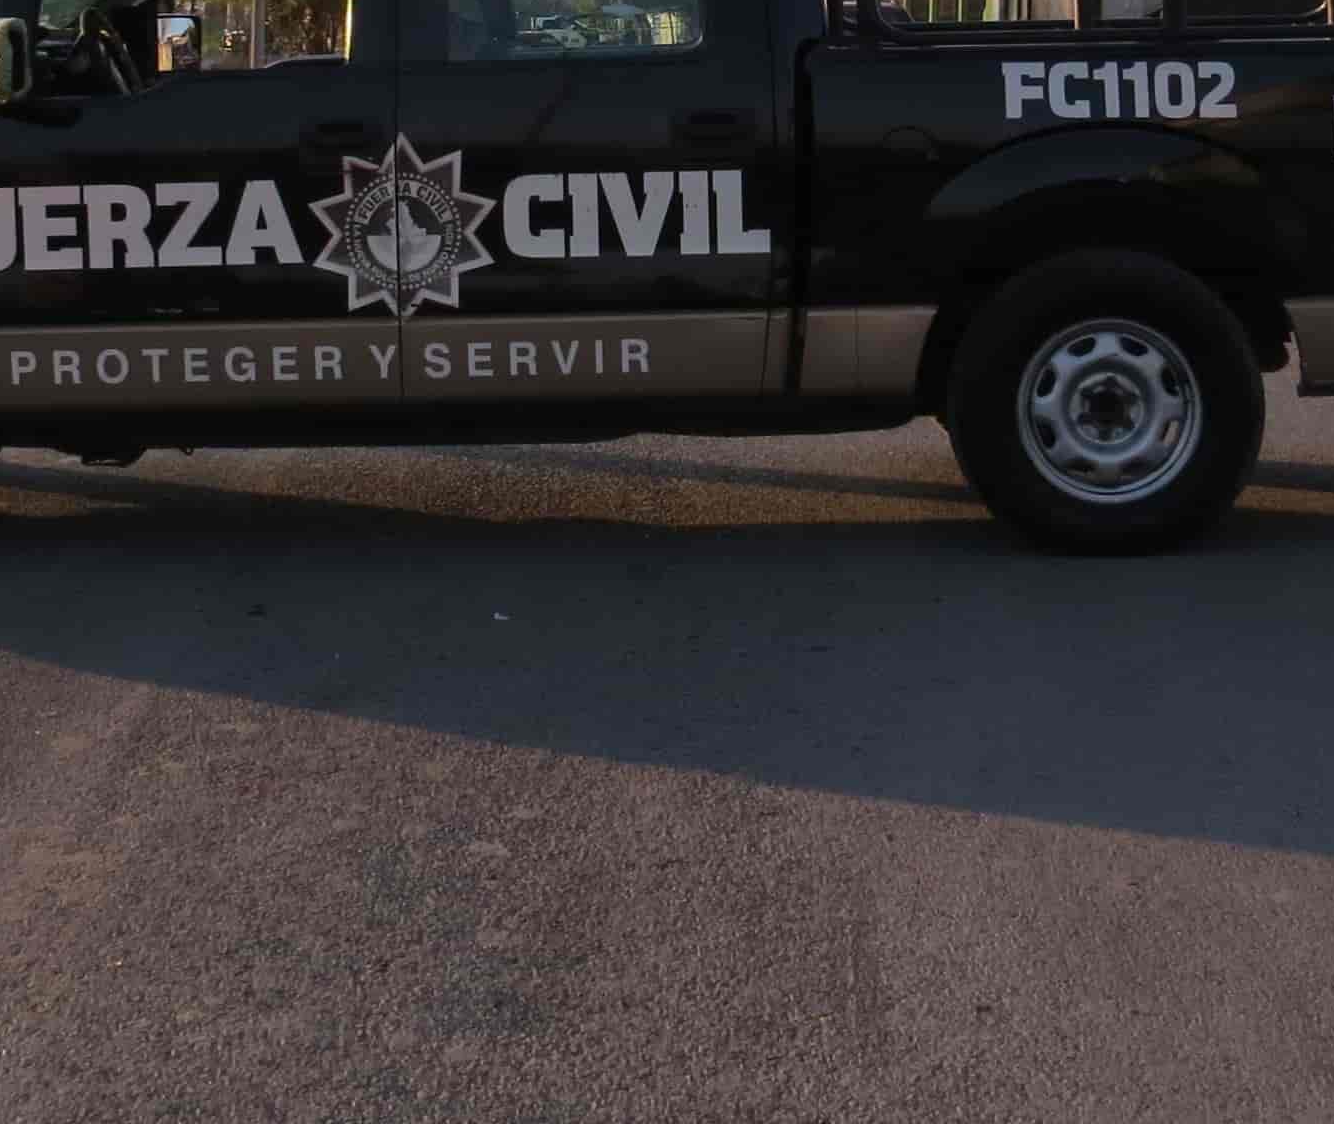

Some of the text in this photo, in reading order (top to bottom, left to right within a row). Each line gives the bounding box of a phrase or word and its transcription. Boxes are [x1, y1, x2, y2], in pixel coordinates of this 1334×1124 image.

[1001, 61, 1238, 119] FC1102
[358, 182, 449, 220] FUERA CIVIL
[503, 170, 771, 259] CIVIL
[10, 338, 650, 385] PROTEGER Y SERVIR
